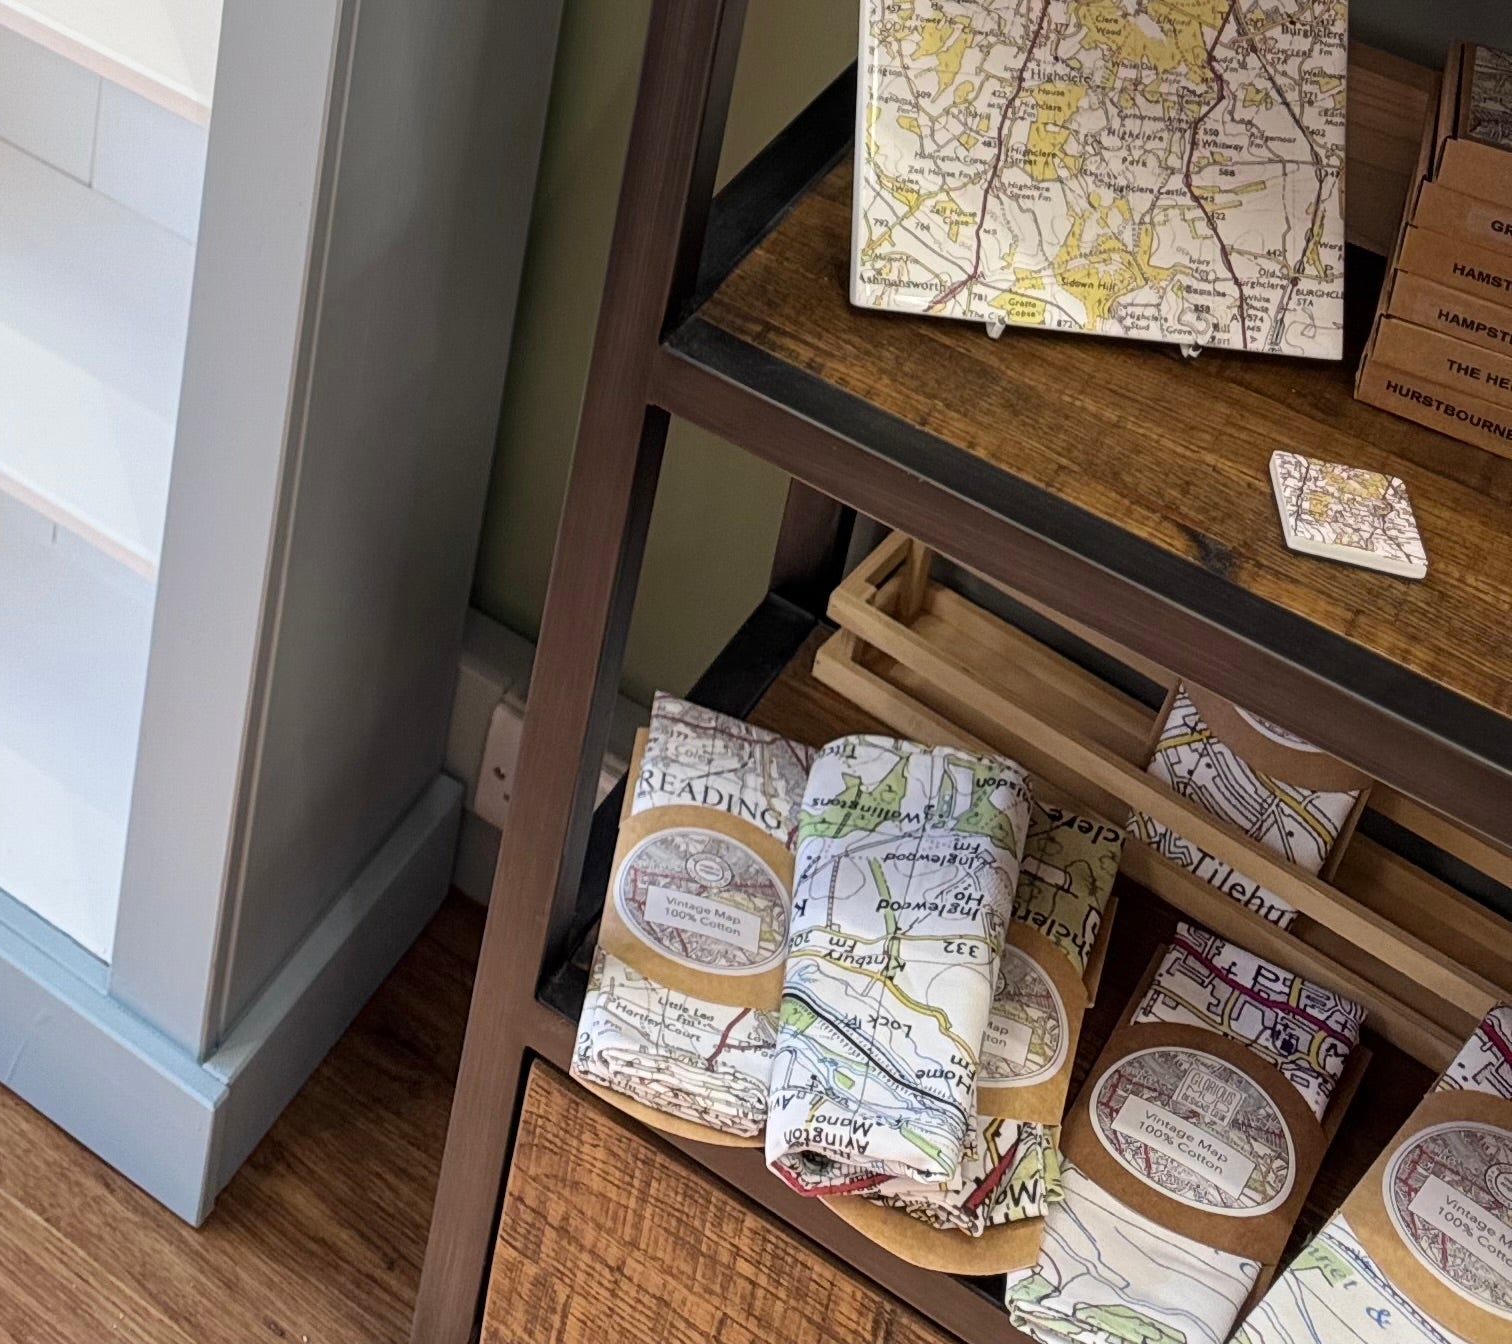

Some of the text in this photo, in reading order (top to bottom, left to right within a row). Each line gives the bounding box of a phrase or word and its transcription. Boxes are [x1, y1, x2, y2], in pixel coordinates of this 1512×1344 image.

[1281, 25, 1345, 40] Burghclere
[1030, 68, 1091, 86] Highclere
[1122, 156, 1147, 168] Park
[859, 274, 946, 292] Ashmansworth
[1061, 277, 1115, 291] Sidown Hill
[1438, 309, 1512, 346] HAMPST
[1447, 359, 1481, 380] THE
[639, 769, 783, 831] READING
[811, 797, 920, 825] Wallingtons
[953, 839, 981, 854] Fm
[884, 851, 975, 869] Inglewood
[666, 895, 741, 926] Vintage Map
[876, 898, 981, 921] Inglewood
[954, 891, 985, 906] Ho
[664, 907, 741, 937] 100% Cotton
[828, 937, 857, 953] Fm
[943, 941, 980, 958] 332
[614, 1001, 661, 1028] Hartley
[658, 996, 689, 1014] Little
[667, 1023, 702, 1043] Court
[868, 1014, 912, 1038] Lock
[915, 1068, 971, 1095] Home
[1191, 1072, 1236, 1105] GLORIOUS
[808, 1114, 873, 1138] Manor
[1145, 1109, 1229, 1164] Vintage Map
[783, 1128, 869, 1154] Avington
[1138, 1120, 1223, 1175] 100% Cotton
[1438, 1206, 1473, 1237] 100%
[1446, 1195, 1496, 1236] Vintage
